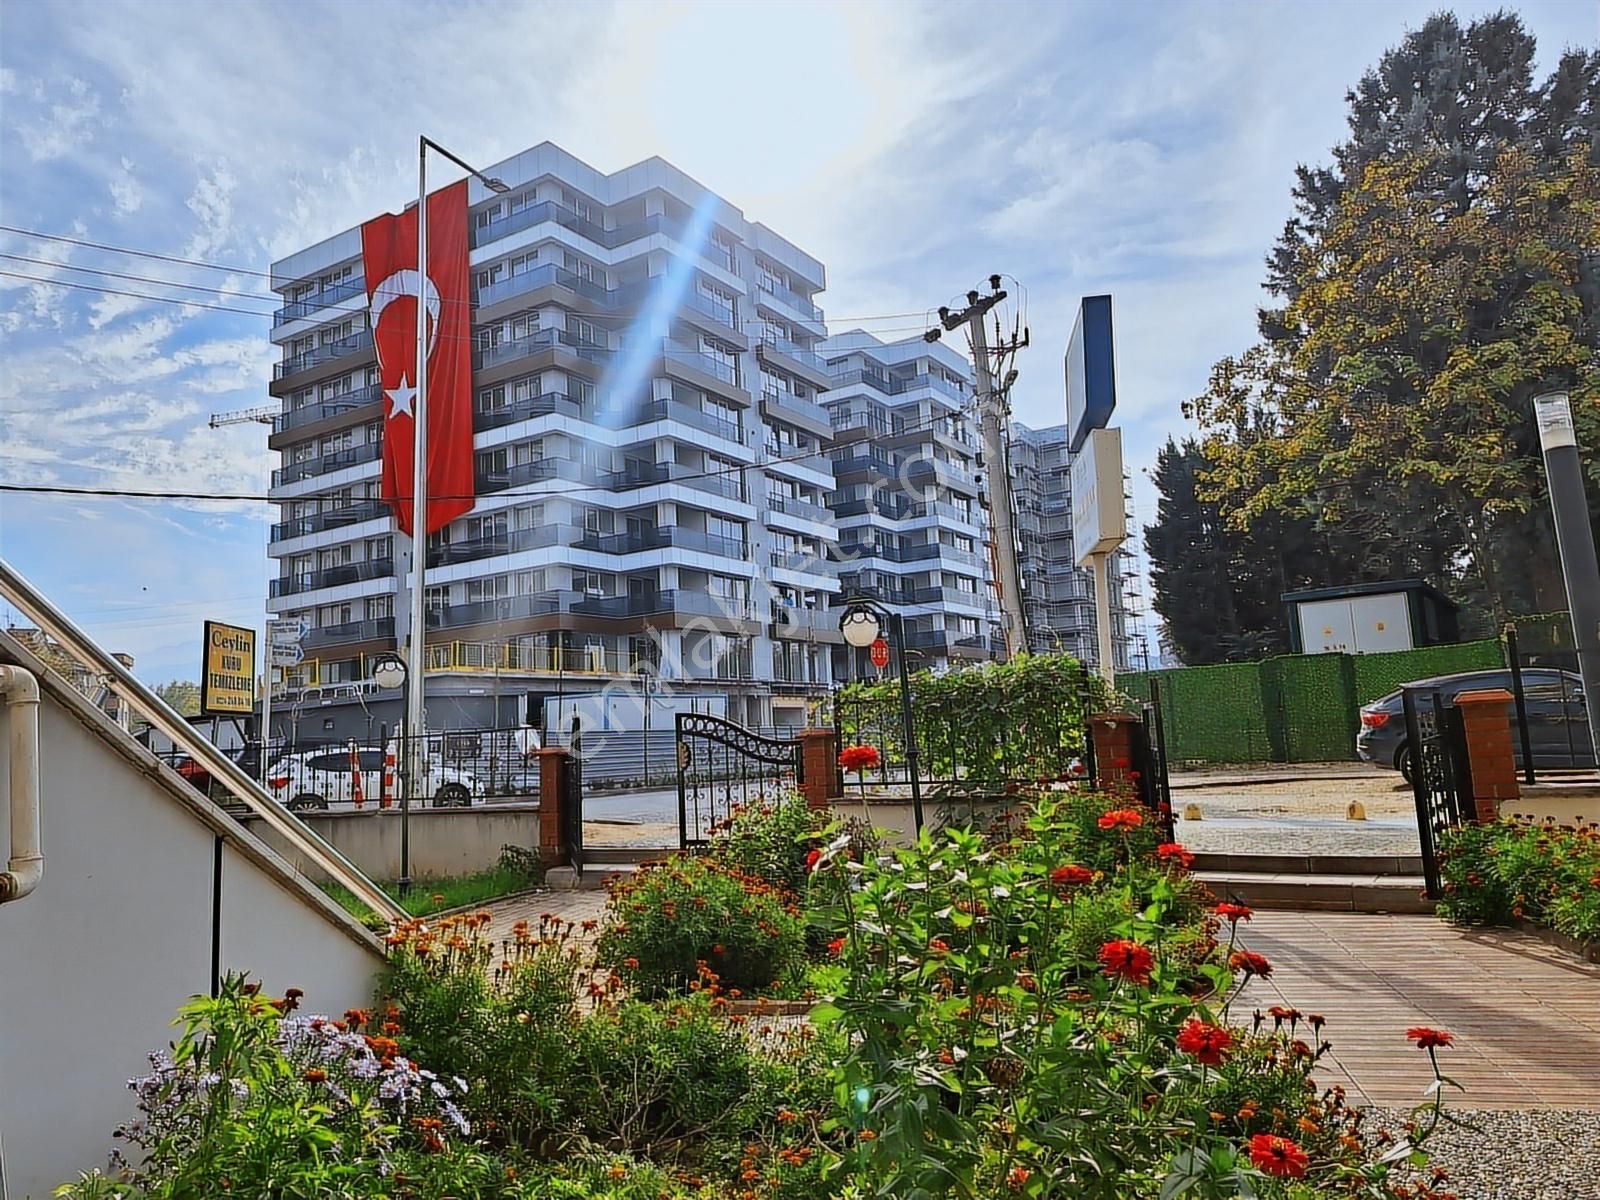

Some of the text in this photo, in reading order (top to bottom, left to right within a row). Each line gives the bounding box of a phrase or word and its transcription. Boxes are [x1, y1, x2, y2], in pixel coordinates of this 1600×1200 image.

[212, 630, 251, 653] Ceylin
[872, 647, 887, 658] DUR
[221, 655, 242, 671] KURU
